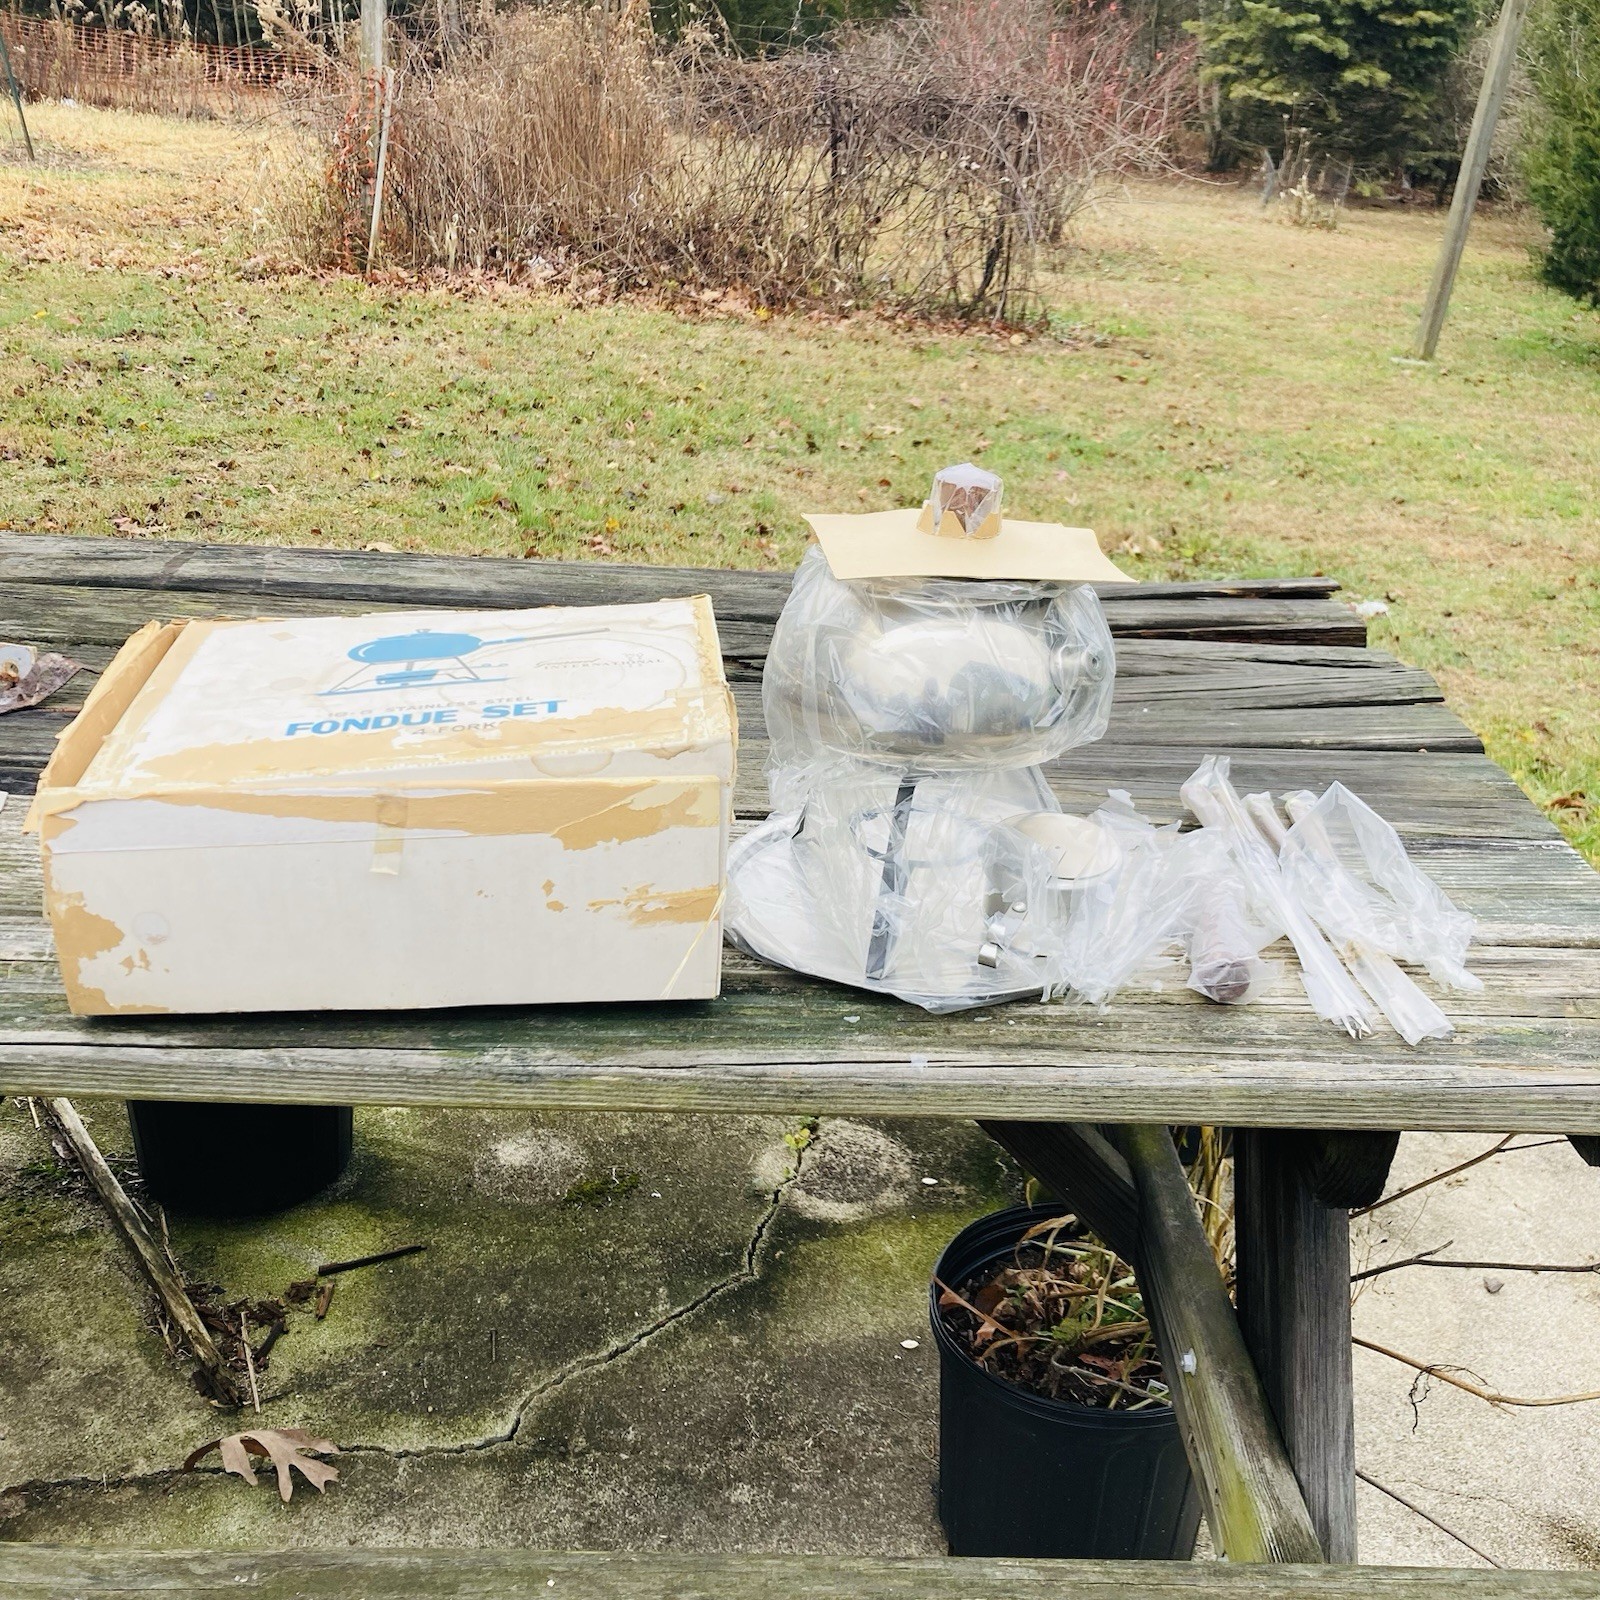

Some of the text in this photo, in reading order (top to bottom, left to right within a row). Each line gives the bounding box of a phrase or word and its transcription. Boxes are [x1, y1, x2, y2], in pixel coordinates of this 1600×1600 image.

[385, 699, 477, 712] STAINLESS
[485, 696, 534, 705] STEEL
[284, 699, 568, 736] FONDUE SET
